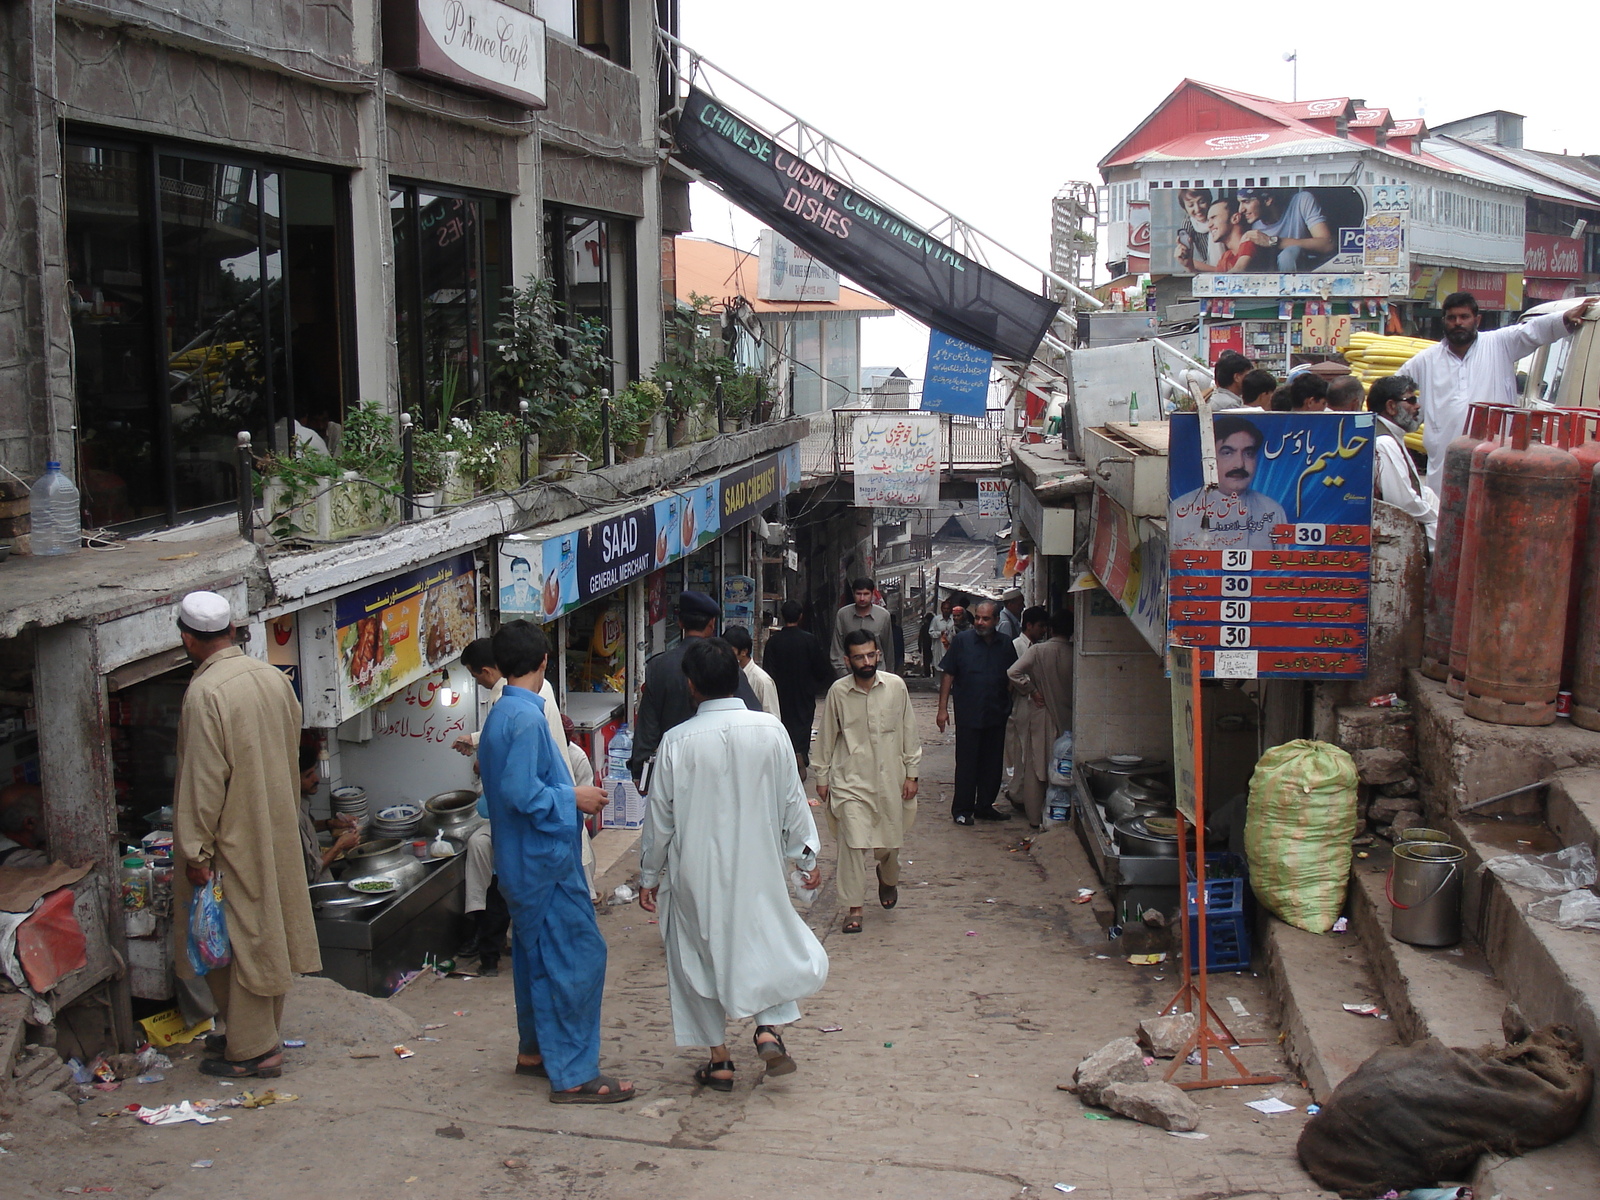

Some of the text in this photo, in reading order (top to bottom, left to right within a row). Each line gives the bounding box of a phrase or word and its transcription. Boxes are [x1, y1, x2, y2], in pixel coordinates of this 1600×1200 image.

[443, 0, 528, 82] Prince Café
[700, 103, 771, 163] CHINESE
[774, 151, 840, 201] CUISINE
[842, 190, 967, 272] CONTINENTAL
[782, 187, 852, 240] DISHES
[1264, 417, 1369, 519] حلیم ہاؤس
[725, 482, 745, 516] SAAD
[747, 467, 776, 505] CHEMIST
[1176, 491, 1247, 519] عاشق پہلوان
[602, 517, 638, 563] SAAD
[1268, 528, 1293, 544] روپے
[1298, 528, 1322, 542] 30
[1183, 554, 1208, 569] روپے
[1226, 551, 1247, 567] 30
[589, 552, 649, 594] GENERAL MERCHANT
[1182, 581, 1207, 595] روپے
[1225, 578, 1249, 592] 30
[1181, 606, 1206, 621] روپے
[1225, 602, 1246, 618] 50
[1225, 626, 1246, 645] 30
[409, 713, 435, 743] چوک
